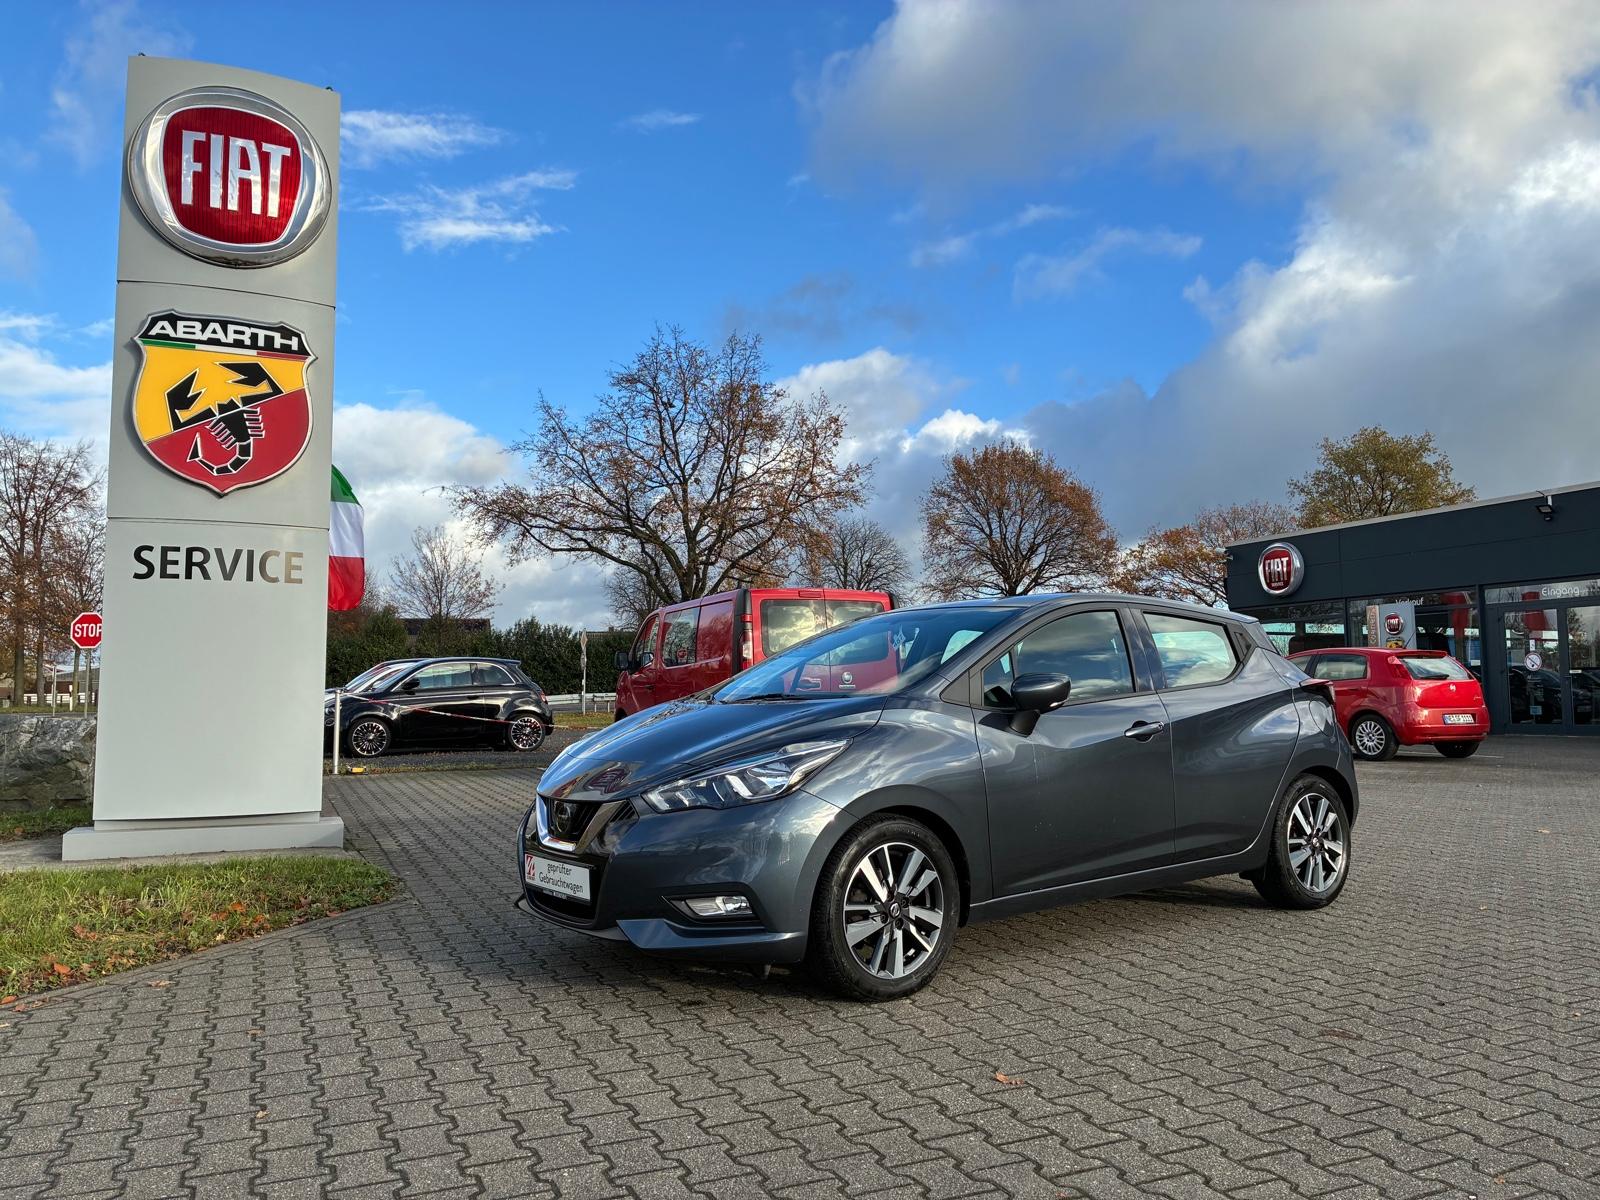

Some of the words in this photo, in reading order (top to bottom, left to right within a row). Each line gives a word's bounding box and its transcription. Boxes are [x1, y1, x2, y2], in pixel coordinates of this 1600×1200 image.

[181, 130, 291, 218] FIAT
[148, 320, 299, 351] ABARTH
[132, 545, 303, 584] SERVICE
[1265, 557, 1289, 583] FIAT
[1541, 586, 1580, 598] Eingang
[74, 623, 103, 638] STOP
[547, 863, 573, 876] geprüfter
[538, 871, 584, 894] Gebrauchtwagen
